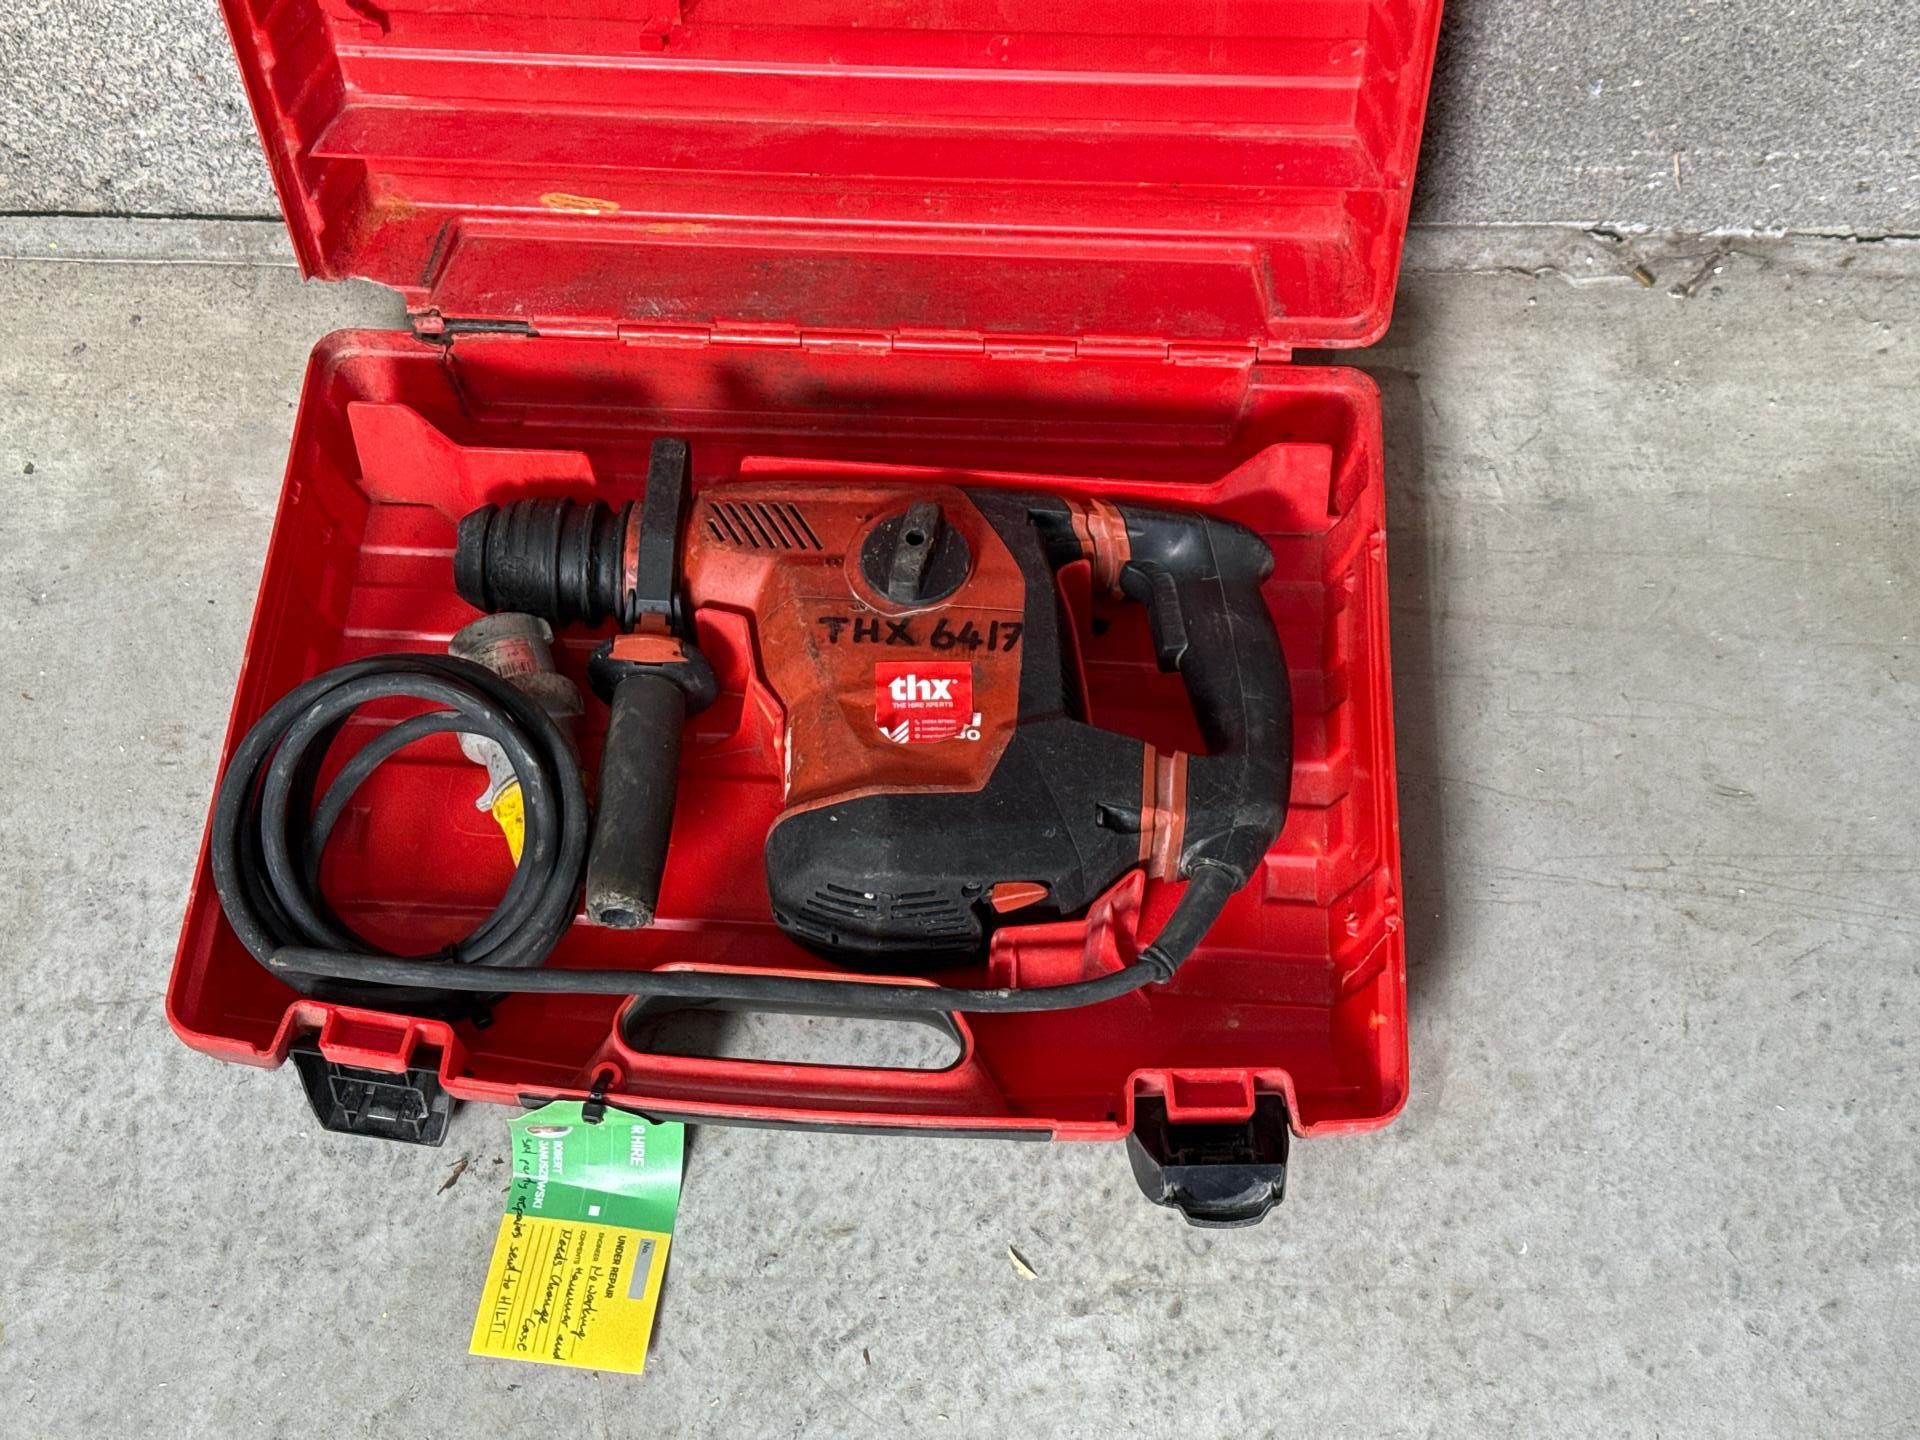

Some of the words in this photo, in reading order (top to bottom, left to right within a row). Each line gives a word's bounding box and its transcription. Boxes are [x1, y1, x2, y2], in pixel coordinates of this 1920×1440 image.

[818, 617, 915, 646] THX
[930, 618, 1023, 652] 6417
[888, 674, 953, 701] thx
[553, 1141, 564, 1175] ROBERT
[630, 1135, 646, 1168] HIRE
[552, 1229, 572, 1267] Needs
[573, 1230, 587, 1265] COMMENTS
[592, 1232, 605, 1262] ENGINEER
[612, 1235, 627, 1265] UNDER
[503, 1274, 516, 1290] to
[604, 1266, 619, 1299] REPAIR
[492, 1296, 511, 1333] HILTI
